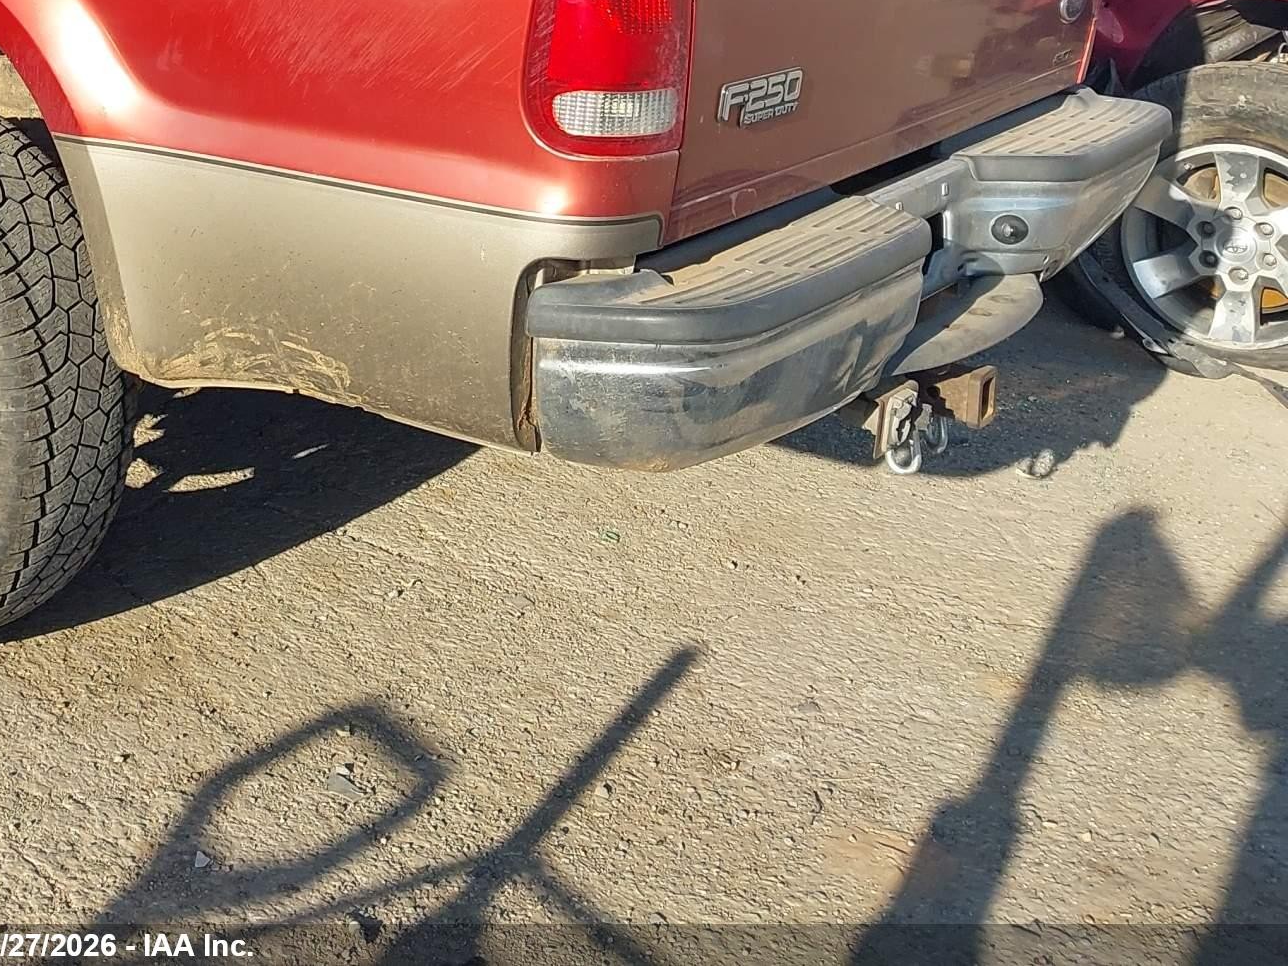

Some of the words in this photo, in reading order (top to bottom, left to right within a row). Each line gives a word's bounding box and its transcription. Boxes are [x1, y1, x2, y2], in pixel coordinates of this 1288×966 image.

[719, 69, 803, 122] F250
[743, 108, 775, 124] SUPER
[775, 101, 799, 117] DUTY
